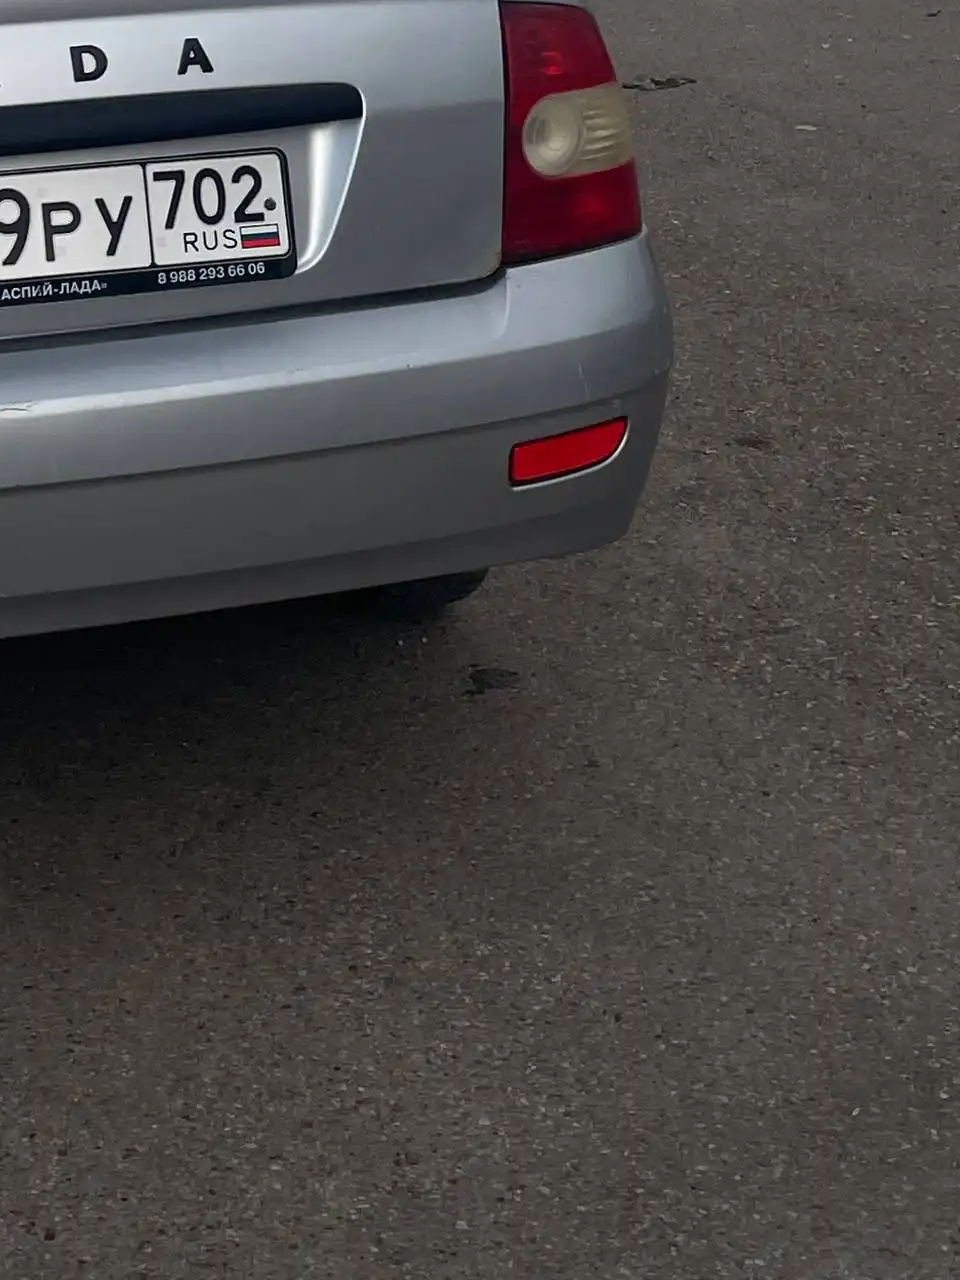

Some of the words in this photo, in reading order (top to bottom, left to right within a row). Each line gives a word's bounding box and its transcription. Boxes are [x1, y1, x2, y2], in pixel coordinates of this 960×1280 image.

[152, 165, 265, 230] 702
[183, 228, 238, 253] RUS
[158, 272, 167, 285] 8
[170, 269, 196, 283] 988
[199, 266, 225, 280] 293
[229, 264, 246, 277] 66
[248, 262, 265, 275] 06
